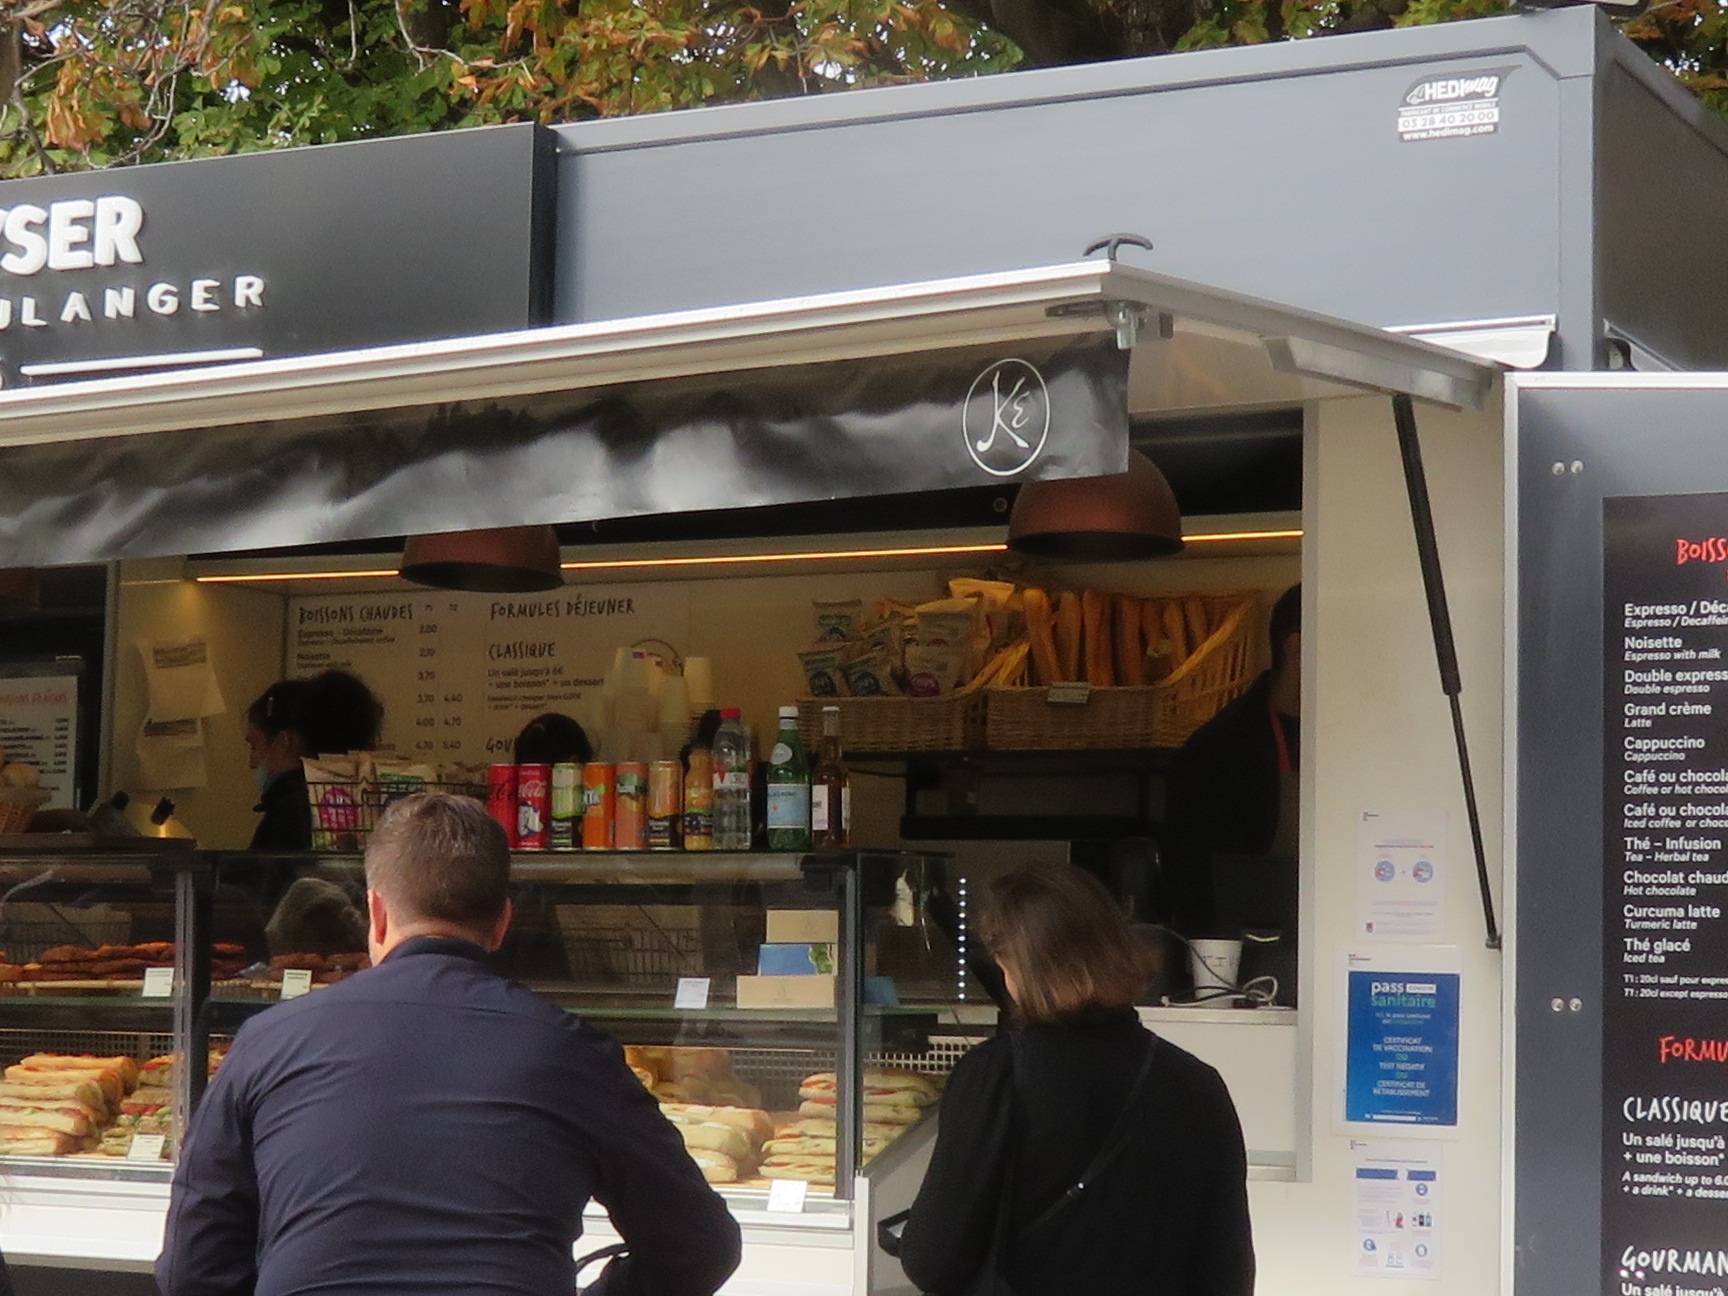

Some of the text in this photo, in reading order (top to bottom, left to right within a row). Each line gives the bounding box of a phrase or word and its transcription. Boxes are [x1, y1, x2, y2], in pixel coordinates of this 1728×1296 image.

[1403, 111, 1494, 128] 03 28 40 20 00
[1403, 125, 1493, 141] www.hedimag.com
[299, 603, 413, 624] BOISSONS CHAUDES
[490, 594, 635, 620] FORMULES DÉJEUNER
[1624, 604, 1687, 618] Expresso
[1624, 636, 1682, 649] Noisette
[489, 642, 556, 660] CLASSIQUE
[1624, 670, 1672, 682] Double
[1624, 702, 1712, 716] Grand crème
[1624, 718, 1652, 728] Latte
[1624, 736, 1705, 750] Cappuccino
[1624, 752, 1685, 762] Cappuccino
[1624, 770, 1656, 783] Café
[1659, 772, 1676, 782] ou
[1624, 803, 1656, 816] Café
[1659, 806, 1676, 816] ou
[1624, 837, 1650, 850] Thé
[1666, 838, 1721, 850] Infusion
[1624, 870, 1684, 884] Chocolat
[1624, 886, 1696, 896] Hot chocolate
[1624, 904, 1720, 918] Curcuma latte
[1624, 938, 1690, 954] Thé glacé
[1371, 982, 1404, 996] pass
[1371, 993, 1436, 1008] sanitaire
